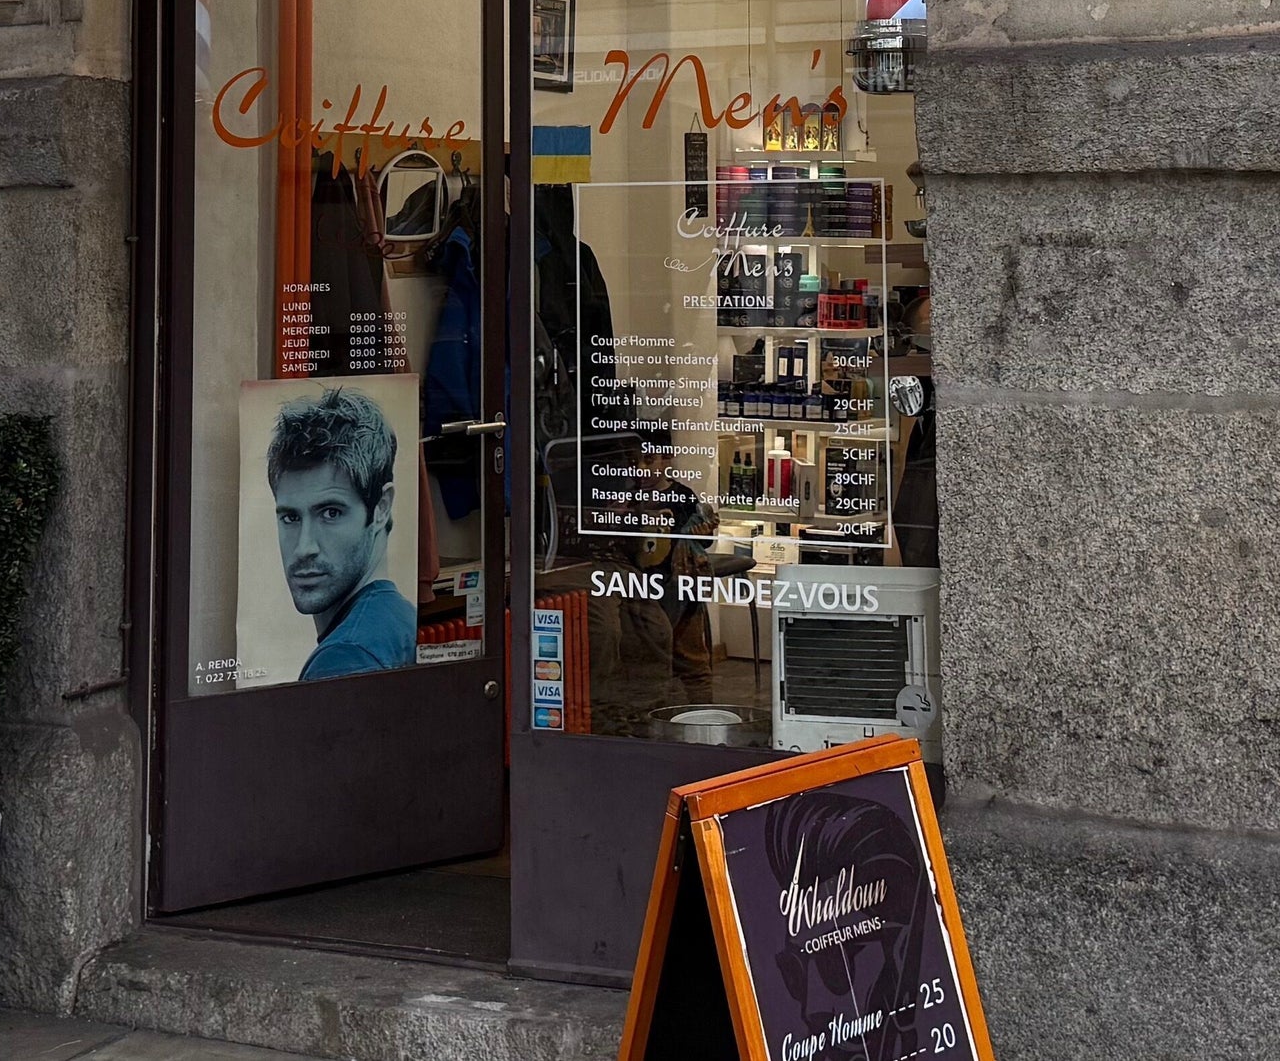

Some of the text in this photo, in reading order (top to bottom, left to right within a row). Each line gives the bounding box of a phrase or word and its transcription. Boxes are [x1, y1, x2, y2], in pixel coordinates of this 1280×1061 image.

[598, 48, 848, 135] Men's
[211, 66, 471, 180] Coiffure
[676, 207, 785, 250] Coiffure
[709, 247, 795, 279] Men's
[283, 283, 331, 293] HORAIRES
[282, 302, 311, 312] LUNDI
[683, 295, 774, 308] PRESTATIONS
[282, 314, 313, 324] MARDI
[350, 313, 376, 322] 09.00
[383, 312, 407, 321] 19.00
[282, 326, 330, 335] MERCREDI
[350, 325, 376, 334] 09.00
[383, 324, 407, 333] 19.00
[282, 338, 310, 348] JEUDI
[350, 337, 376, 346] 09.00
[383, 336, 407, 345] 19.00
[591, 334, 675, 348] Coupe Homme
[282, 350, 330, 360] VENDREDI
[350, 349, 376, 358] 09.00
[383, 348, 407, 357] 19.00
[591, 352, 645, 366] Classique
[648, 355, 662, 364] ou
[665, 353, 719, 366] tendance
[282, 362, 318, 372] SAMEDI
[350, 360, 376, 369] 09.00
[383, 359, 406, 368] 17.00
[591, 376, 628, 390] Coupe
[630, 377, 676, 388] Homme
[591, 393, 704, 409] (Tout à la tondeuse)
[833, 398, 874, 411] 29CHF
[591, 417, 628, 431] Coupe
[630, 418, 668, 432] simple
[834, 423, 875, 436] 25CHF
[641, 442, 875, 461] Shampooing 5CHF
[591, 464, 652, 477] Coloration
[664, 466, 702, 480] Coupe
[835, 473, 876, 485] 89CHF
[591, 487, 633, 503] Rasage
[635, 489, 650, 501] de
[652, 490, 686, 503] Barbe
[700, 492, 754, 506] Serviette
[755, 494, 800, 507] chaude
[835, 497, 876, 511] 29CHF
[591, 512, 877, 535] Taille de Barbe 20CHF
[590, 570, 880, 612] SANS RENDEZ-VOUS
[537, 614, 560, 625] VISA
[208, 658, 243, 670] RENDA
[205, 672, 224, 684] 022
[538, 686, 561, 697] VISA
[779, 832, 888, 936] Khaldoun
[782, 977, 945, 1061] Coupe Homme 25
[930, 1022, 956, 1054] 20
